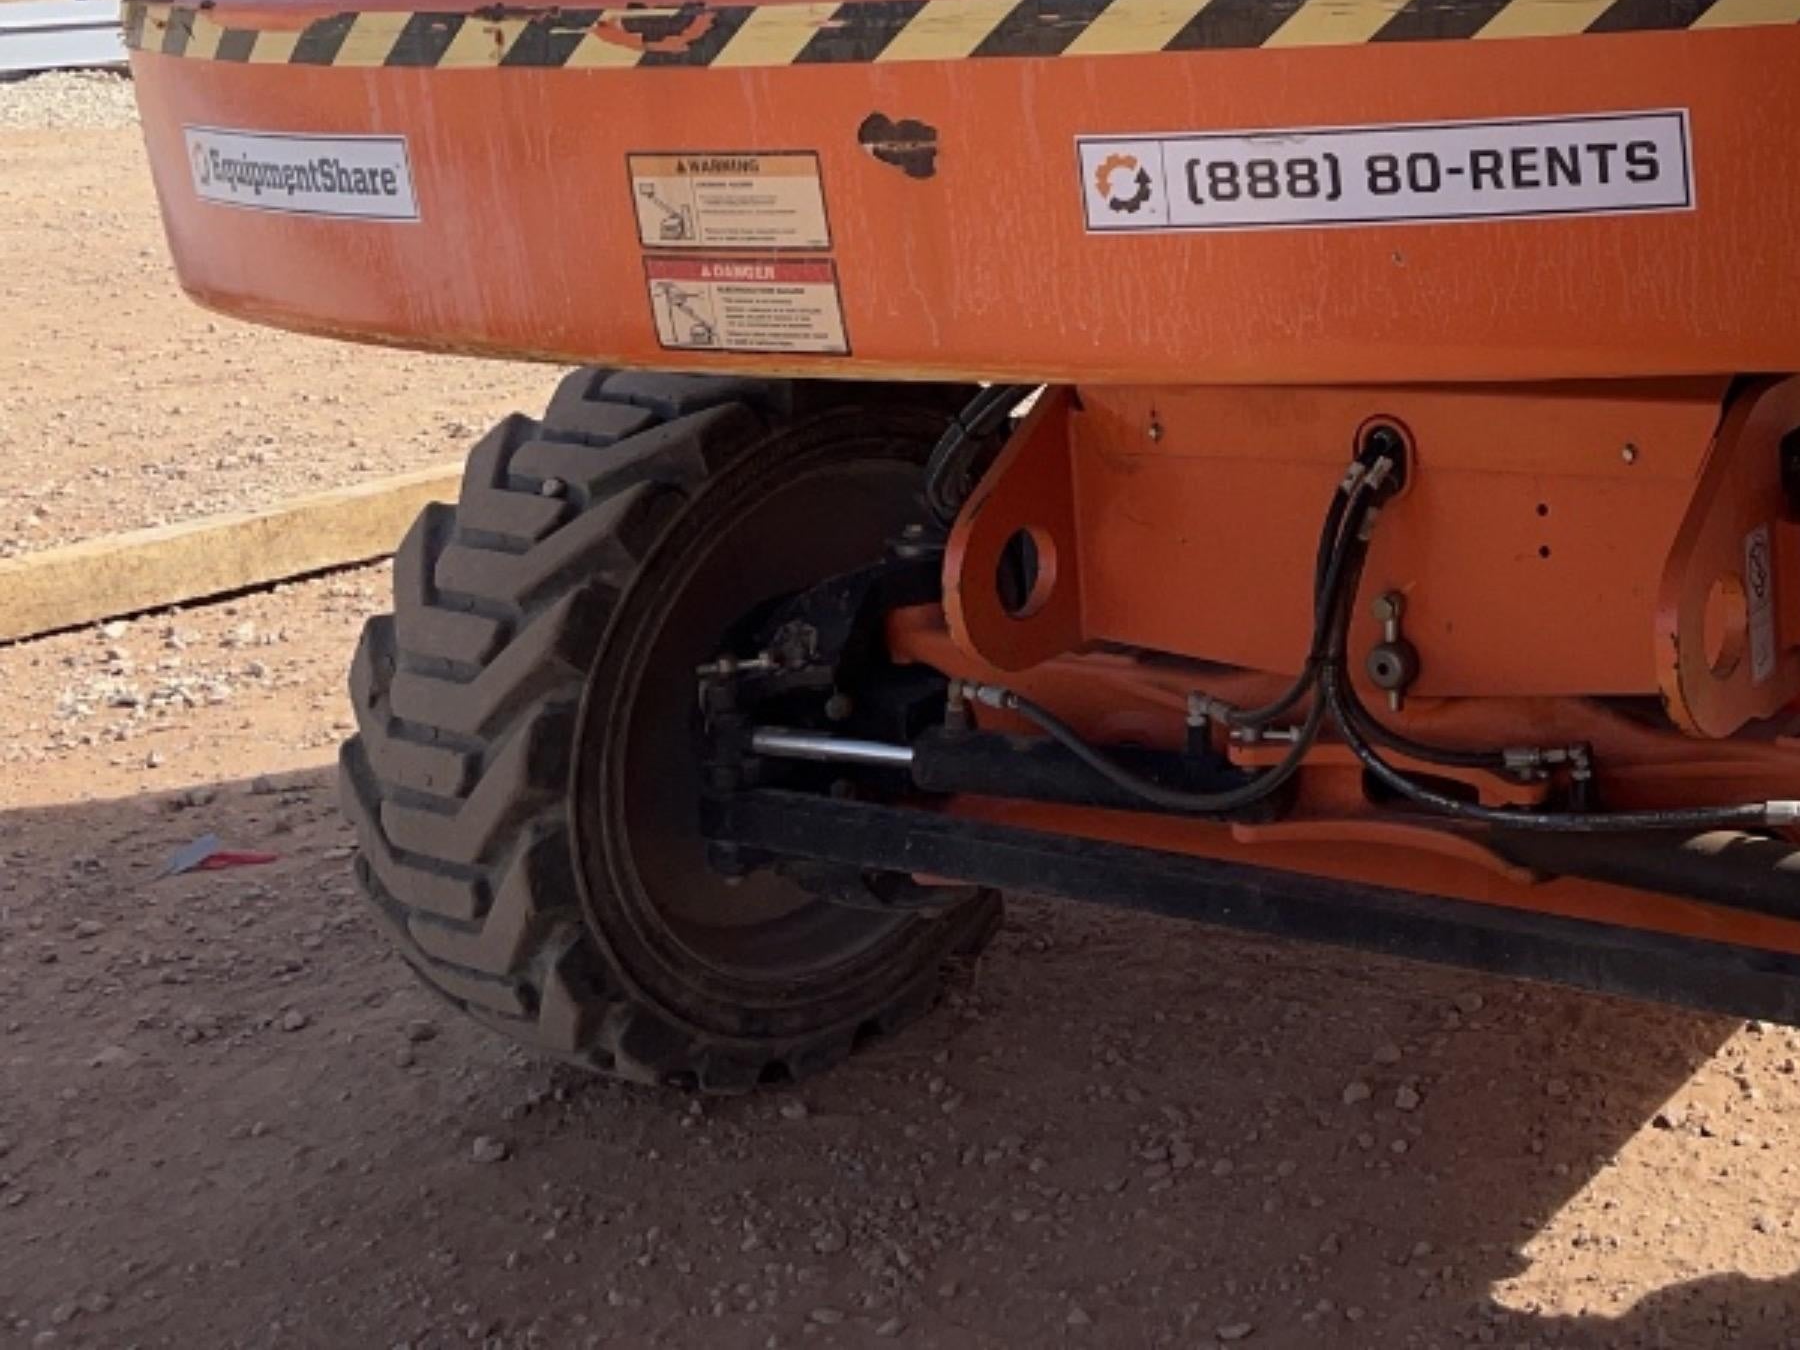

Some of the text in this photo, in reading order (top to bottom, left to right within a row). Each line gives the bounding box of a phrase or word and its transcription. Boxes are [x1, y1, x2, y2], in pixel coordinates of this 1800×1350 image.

[210, 148, 398, 197] EquipmentShare
[687, 158, 760, 173] WARNING
[1185, 140, 1661, 204] (888) 80-RENTS
[713, 264, 776, 280] DANGER
